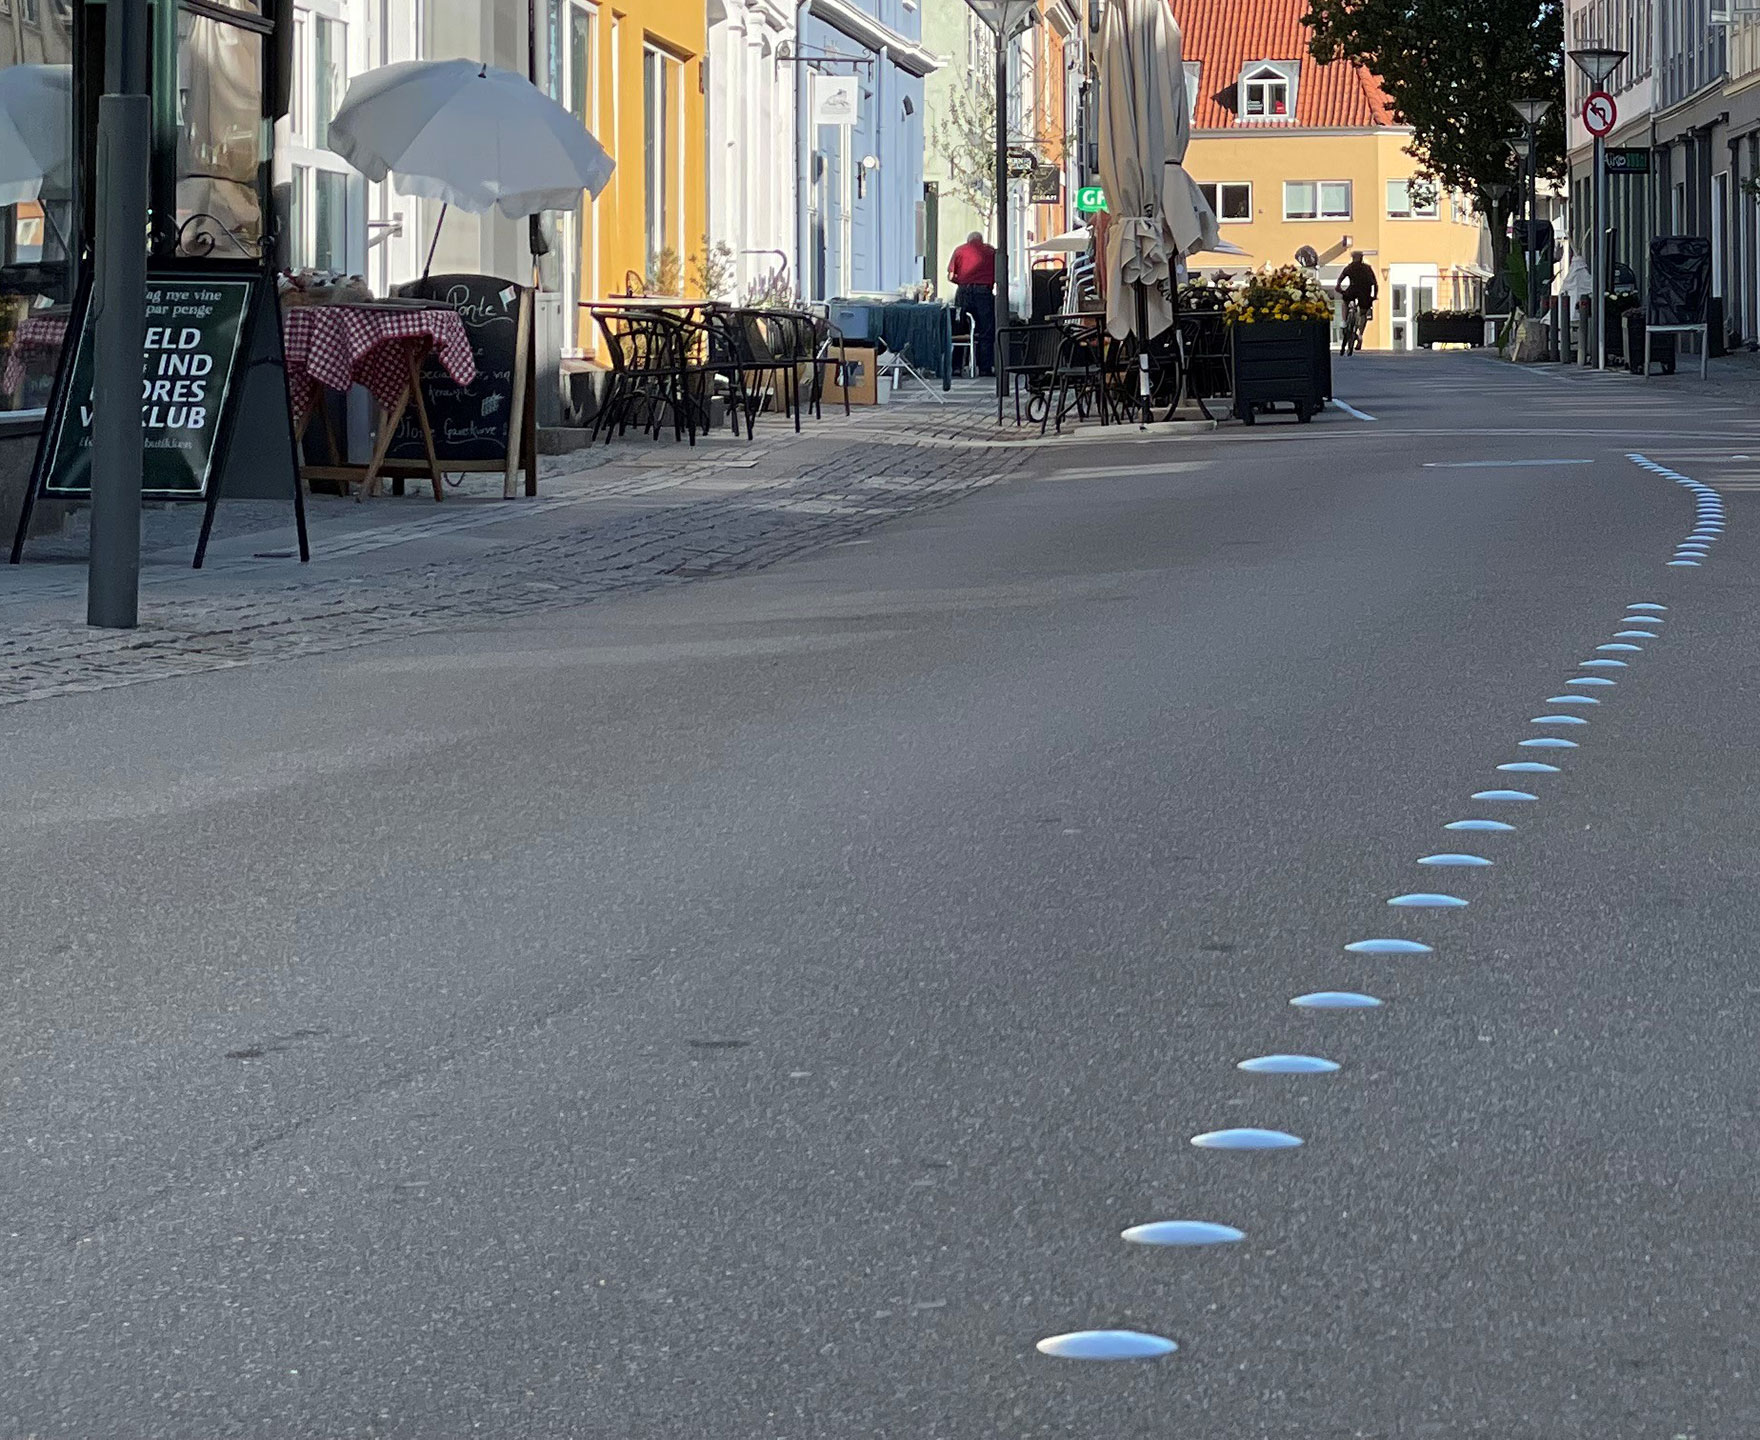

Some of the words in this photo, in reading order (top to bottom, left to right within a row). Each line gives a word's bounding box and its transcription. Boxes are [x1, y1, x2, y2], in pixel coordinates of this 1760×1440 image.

[145, 291, 161, 303] ag
[166, 291, 189, 303] nye
[194, 290, 222, 301] vine
[145, 305, 169, 317] par
[172, 306, 213, 318] penge
[143, 327, 201, 349] ELD
[157, 353, 213, 376] IND
[142, 379, 207, 402] RES
